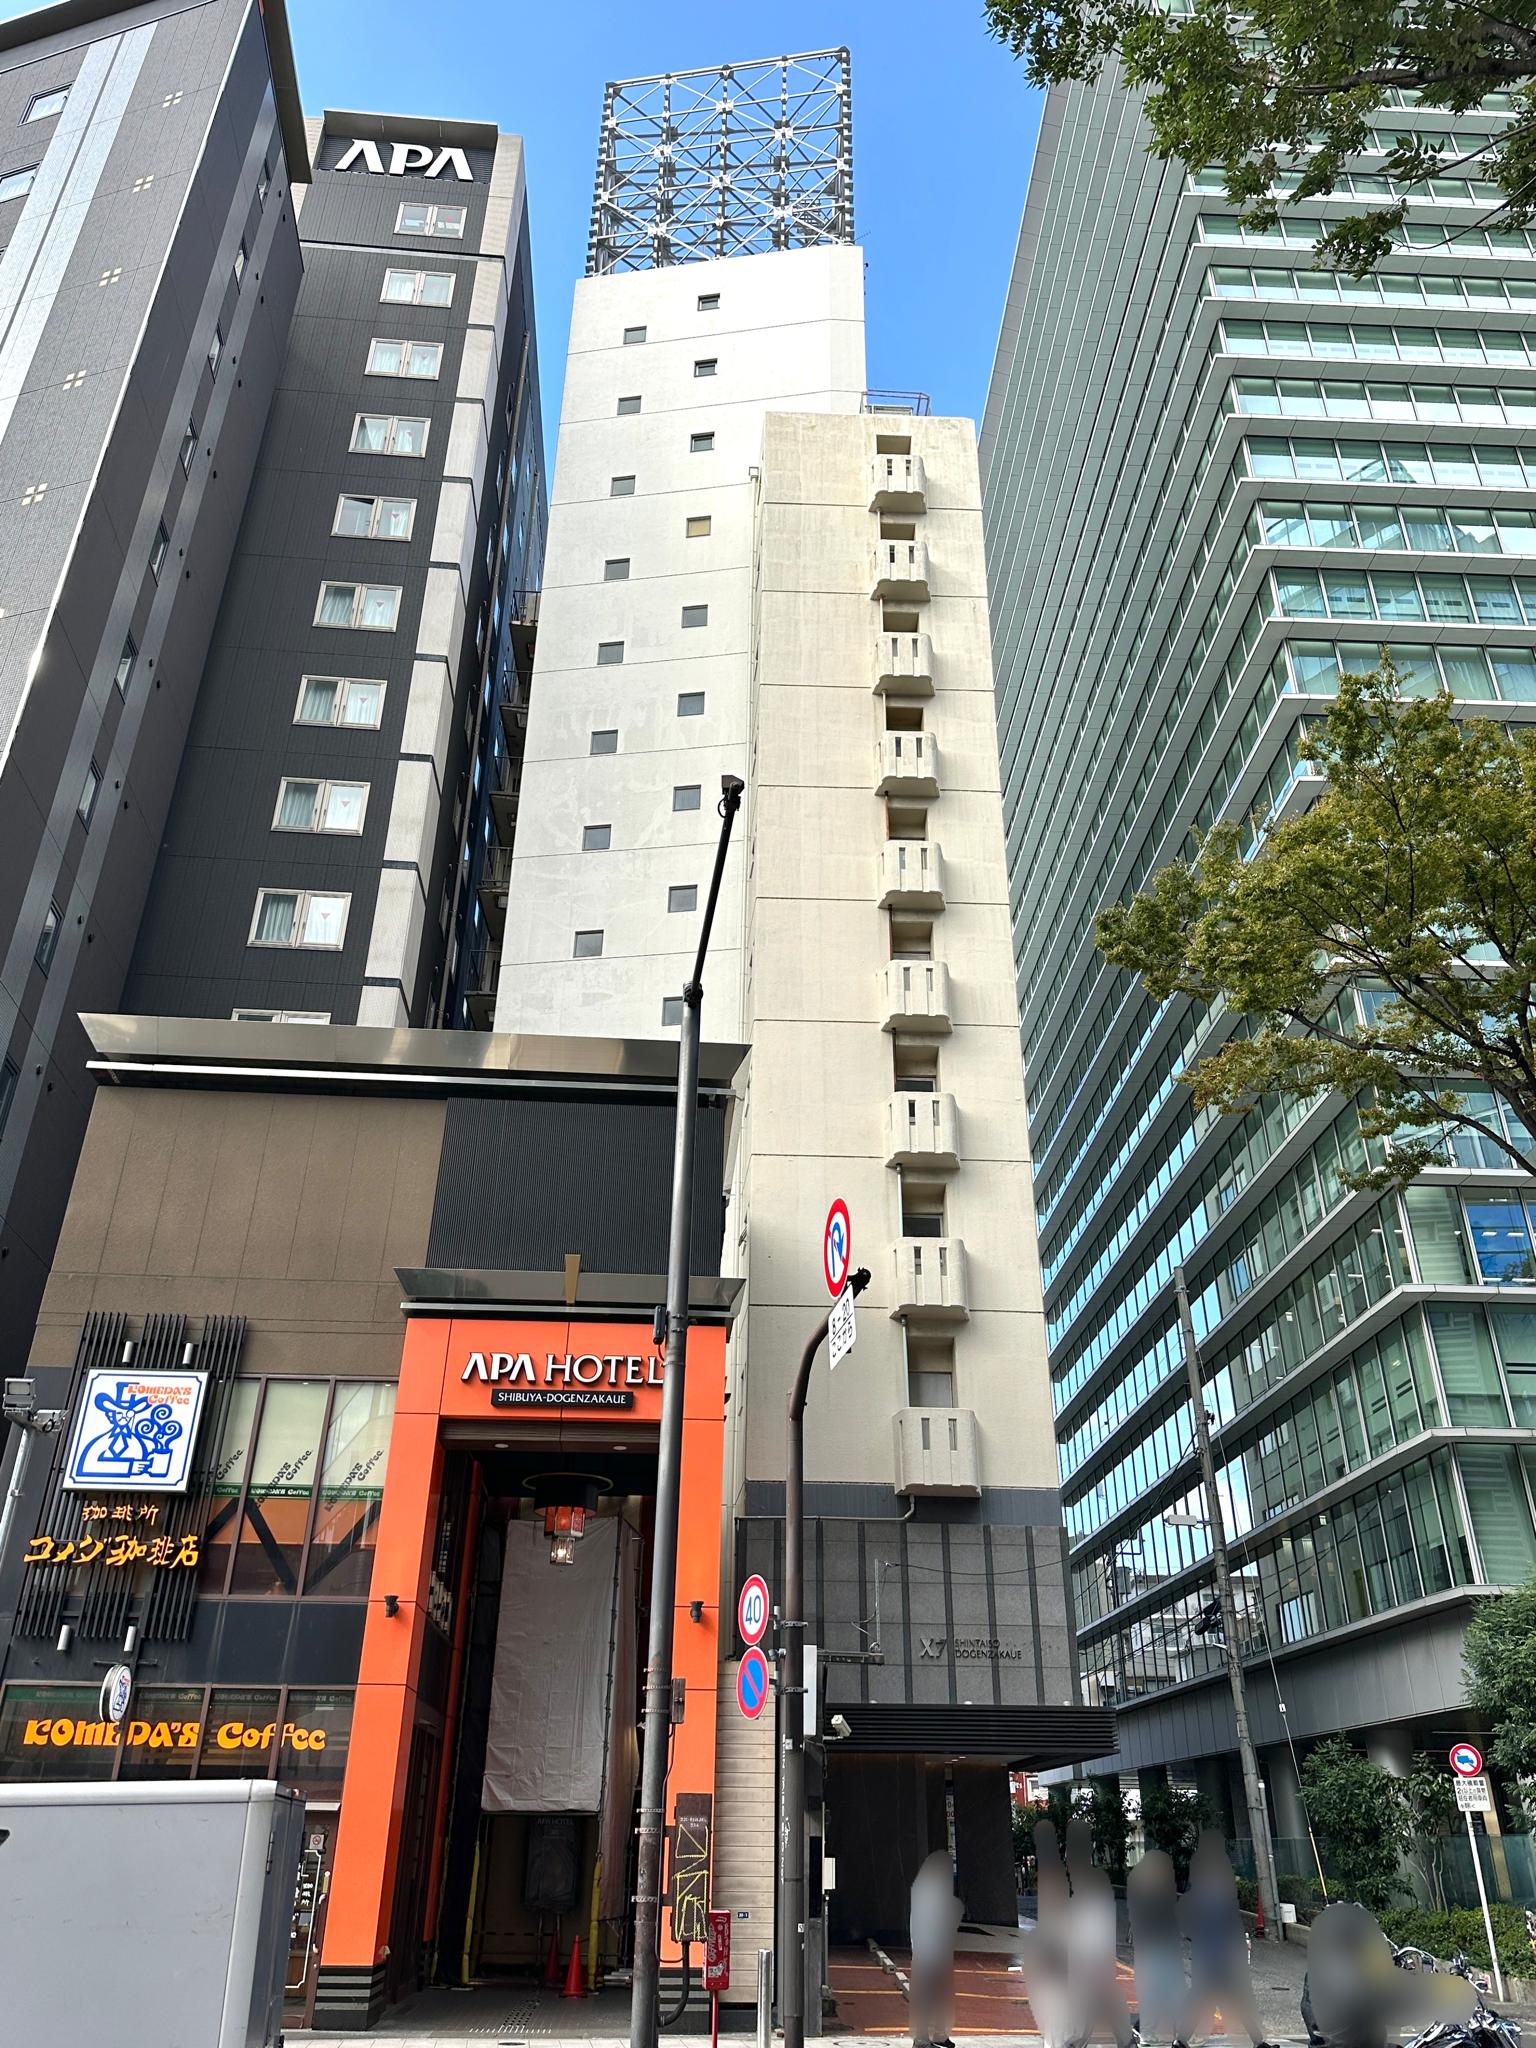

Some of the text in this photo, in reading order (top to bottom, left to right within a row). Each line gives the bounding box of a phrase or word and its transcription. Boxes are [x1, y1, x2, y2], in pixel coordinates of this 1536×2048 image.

[335, 139, 473, 181] APA
[831, 1298, 850, 1335] 8-20
[461, 1352, 664, 1385] APA HOTEL
[149, 1395, 190, 1405] Coffee
[497, 1391, 627, 1405] SHIBUYA-DOGENZAKAUE
[285, 1449, 313, 1481] Coffee
[357, 1450, 384, 1481] Coffee
[82, 1504, 159, 1526] 珈琲所
[24, 1534, 199, 1569] コメダ珈琲店
[745, 1594, 761, 1625] 40
[955, 1650, 1022, 1659] DOGENZAKAUE
[24, 1718, 326, 1750] KOMEDA'S Coffee
